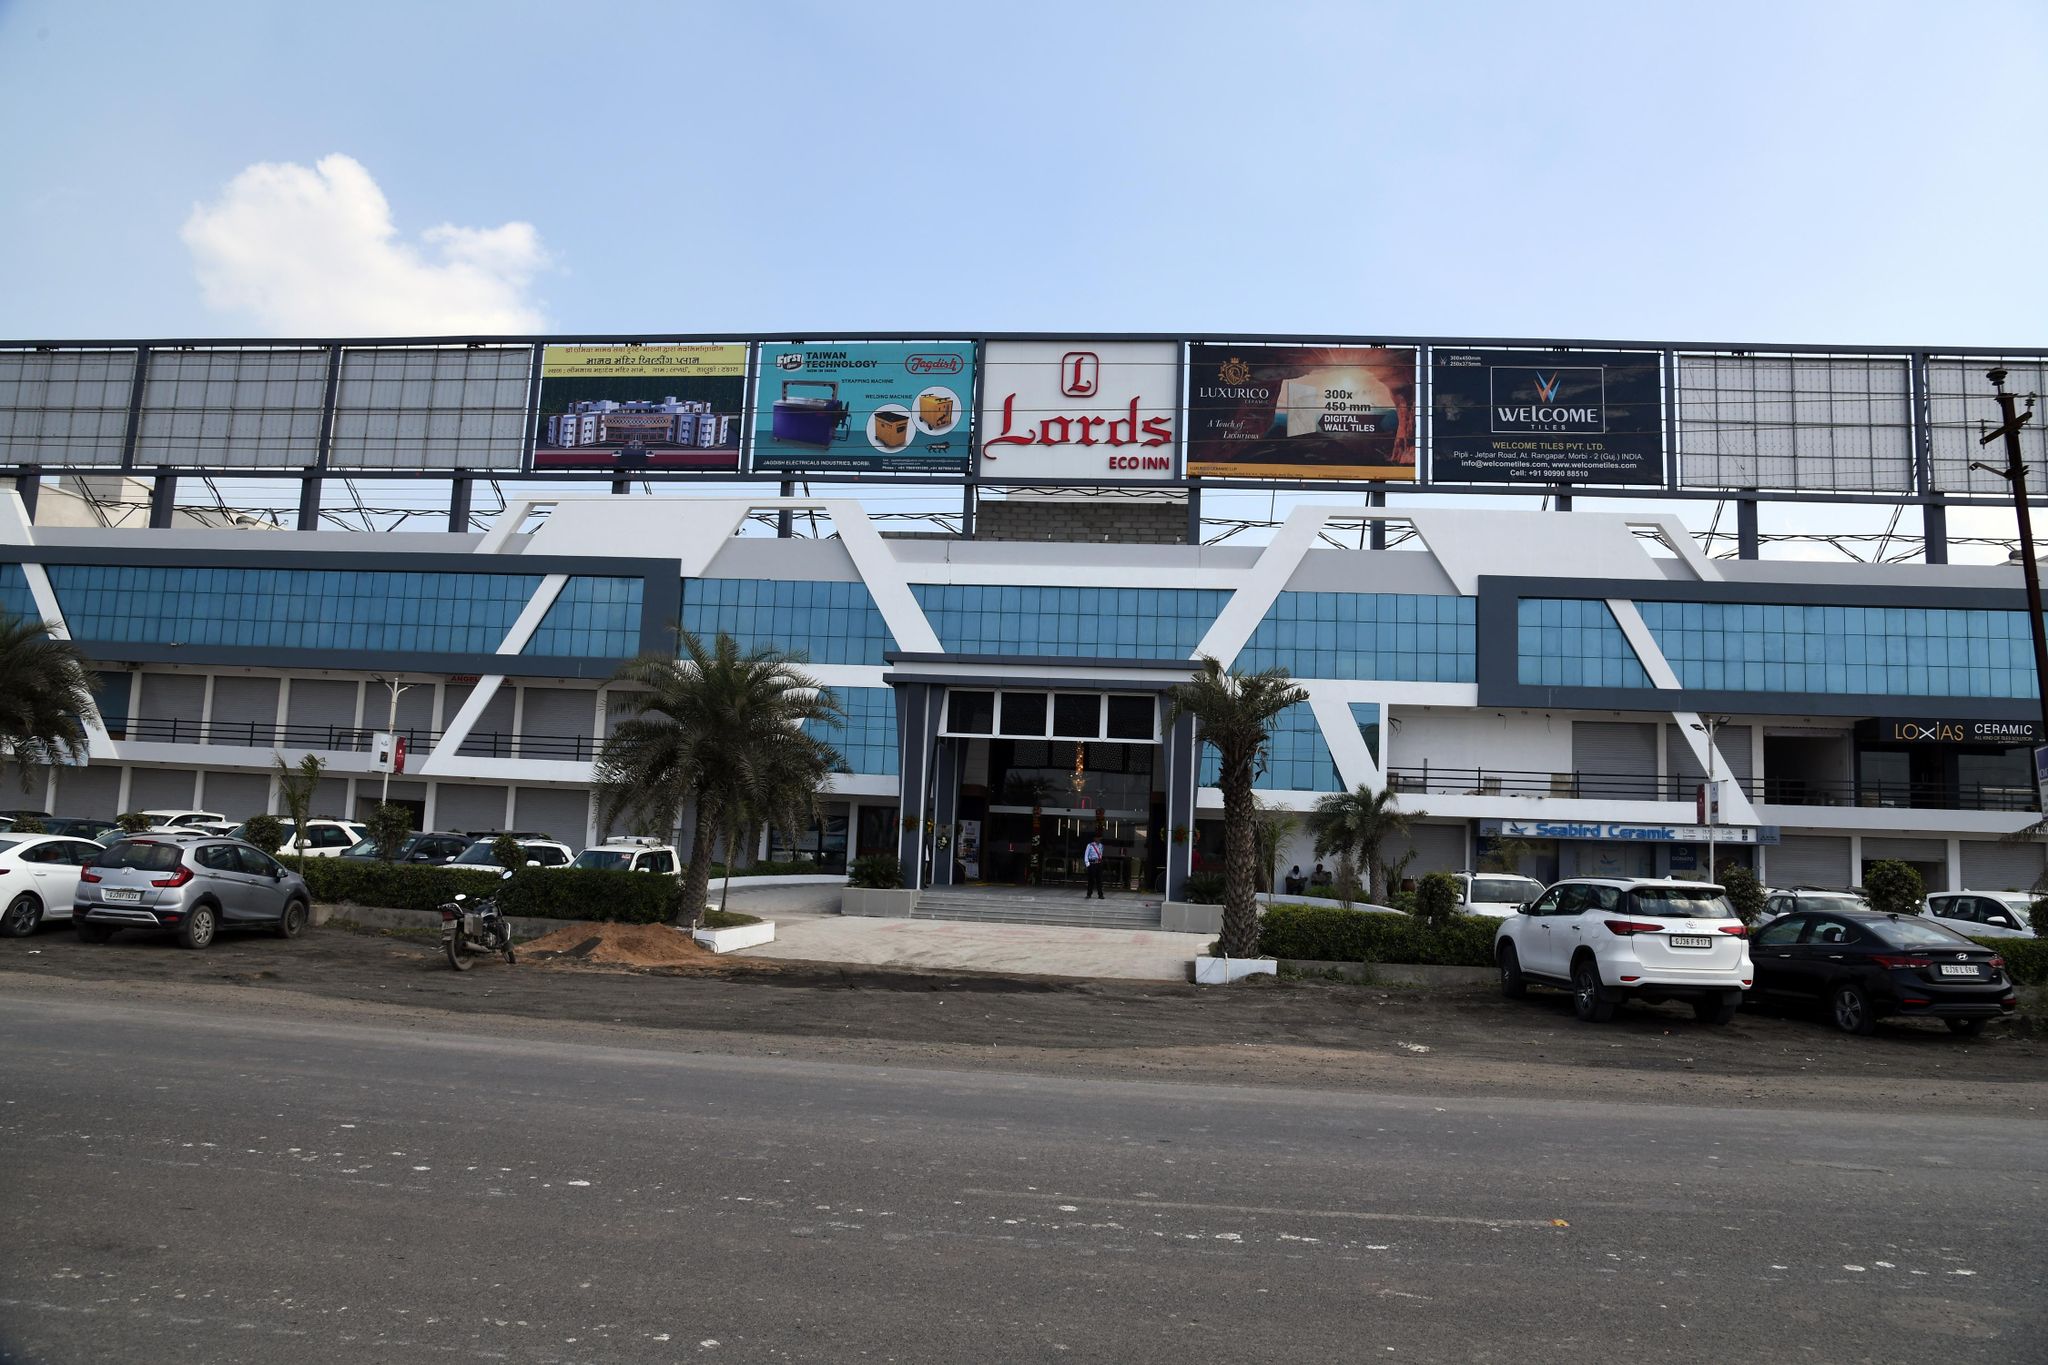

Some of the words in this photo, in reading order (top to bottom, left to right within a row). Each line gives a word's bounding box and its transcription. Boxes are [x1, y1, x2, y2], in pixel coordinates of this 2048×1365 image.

[614, 355, 636, 364] મંદિર
[805, 352, 847, 360] TAIWAN
[805, 360, 878, 368] TECHNOLOGY
[911, 358, 957, 372] Jagdish
[1200, 387, 1269, 400] LUXURICO
[1324, 389, 1353, 400] 300x
[1324, 402, 1346, 411] 450
[1324, 415, 1359, 423] DIGITAL
[982, 393, 1172, 460] Lords
[1324, 423, 1349, 431] WALL
[1350, 424, 1375, 432] TILES
[1223, 430, 1259, 440] Luxurious
[1492, 442, 1537, 450] WELCOME
[1539, 442, 1564, 450] TILES
[1586, 443, 1606, 451] LTD.
[1474, 451, 1496, 460] Jetpar
[1568, 452, 1588, 460] Morbi
[1109, 456, 1139, 470] ECO
[1142, 457, 1170, 470] INN
[1461, 460, 1550, 469] info@welcometiles.com,
[1974, 723, 2033, 735] CERAMIC
[1536, 823, 1601, 837] Seabird
[1608, 824, 1675, 840] Ceramic
